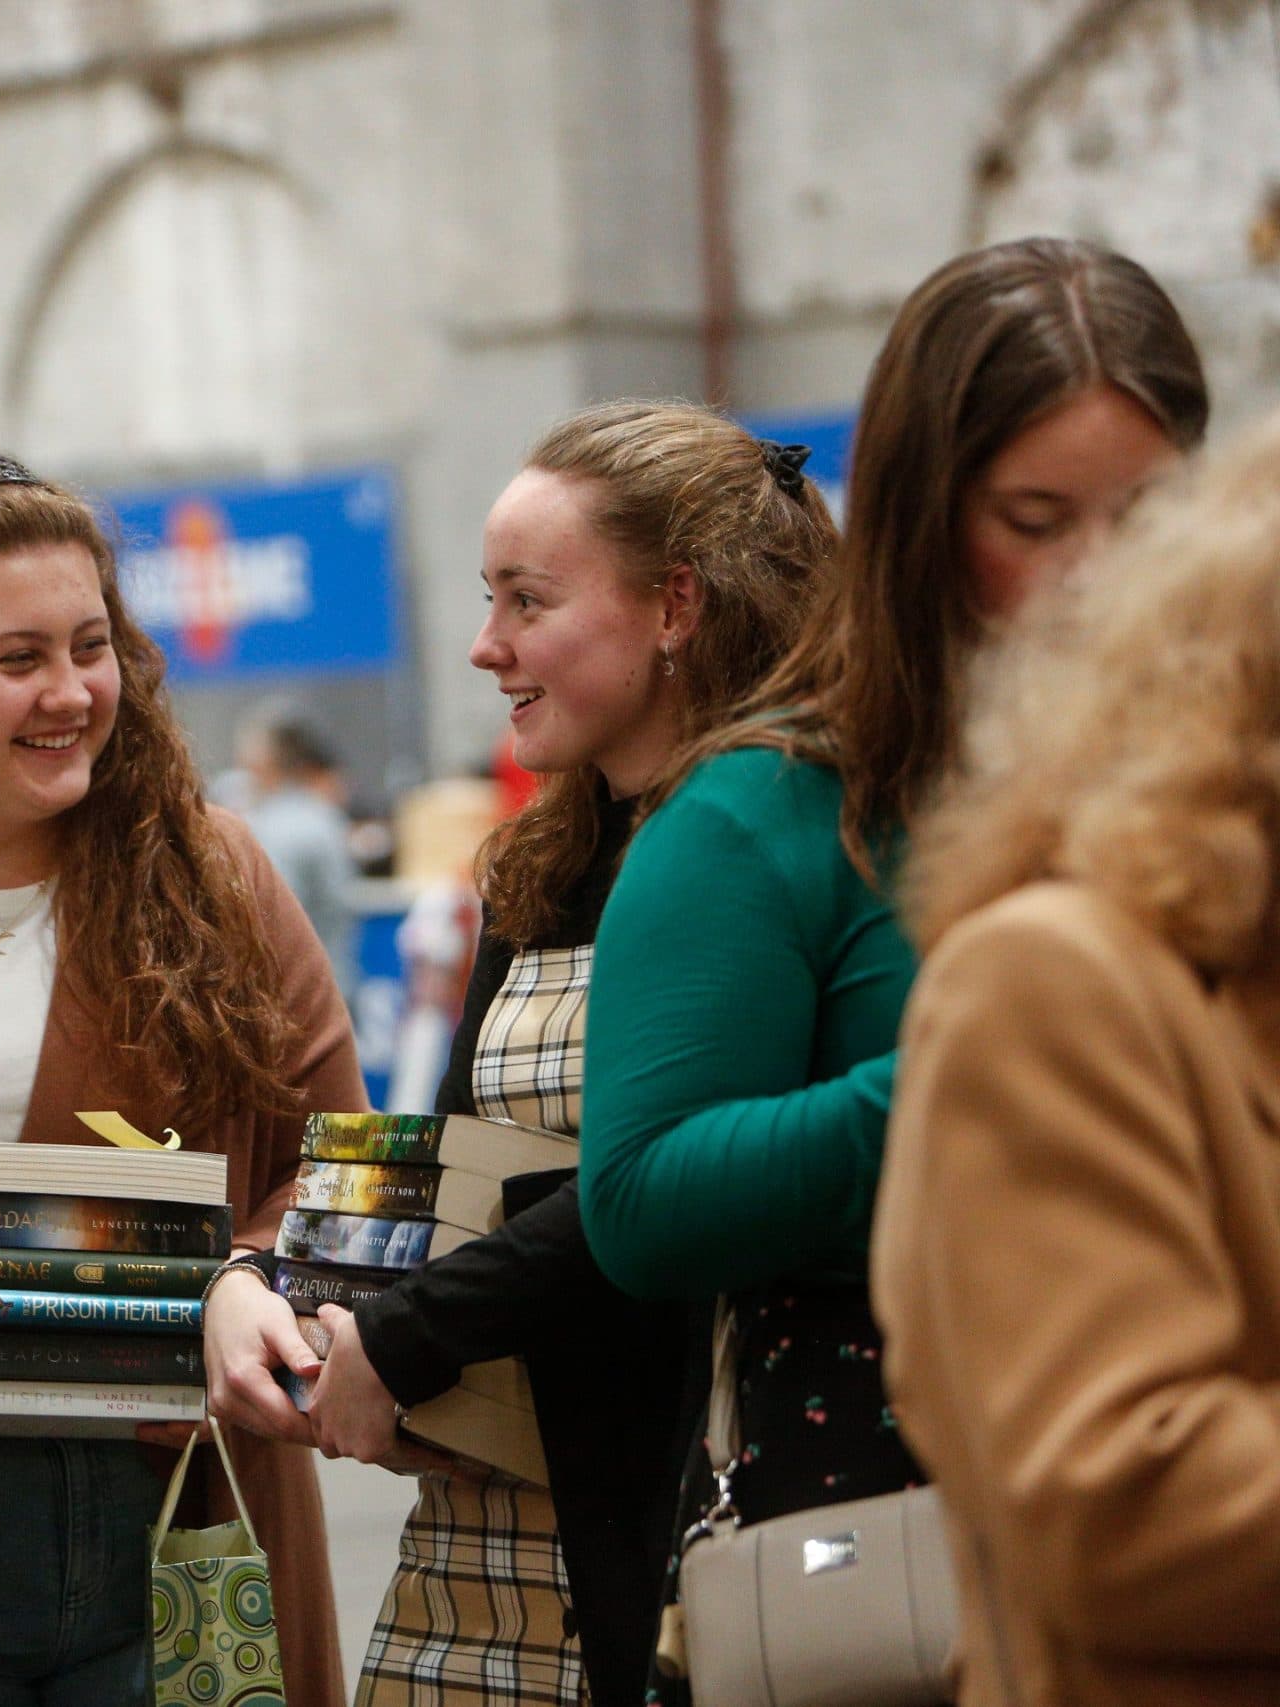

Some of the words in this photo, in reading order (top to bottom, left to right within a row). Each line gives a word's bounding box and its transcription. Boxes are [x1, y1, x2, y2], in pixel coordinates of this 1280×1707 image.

[372, 1132, 400, 1141] LYNETTE
[403, 1132, 419, 1142] NONI
[367, 1184, 397, 1196] LYNETTE
[398, 1187, 416, 1197] NONI
[91, 1219, 147, 1231] LYNETTE
[152, 1223, 186, 1233] NONI
[117, 1262, 168, 1274] LYNETTE
[127, 1276, 158, 1288] NONI
[286, 1276, 344, 1301] GRAEVALE
[351, 1289, 383, 1300] LYNETT
[32, 1296, 107, 1321] PRISON
[113, 1299, 194, 1326] HEALER
[113, 1360, 149, 1369] NONI
[94, 1392, 153, 1402] LYNETTE
[106, 1402, 140, 1412] NONI
